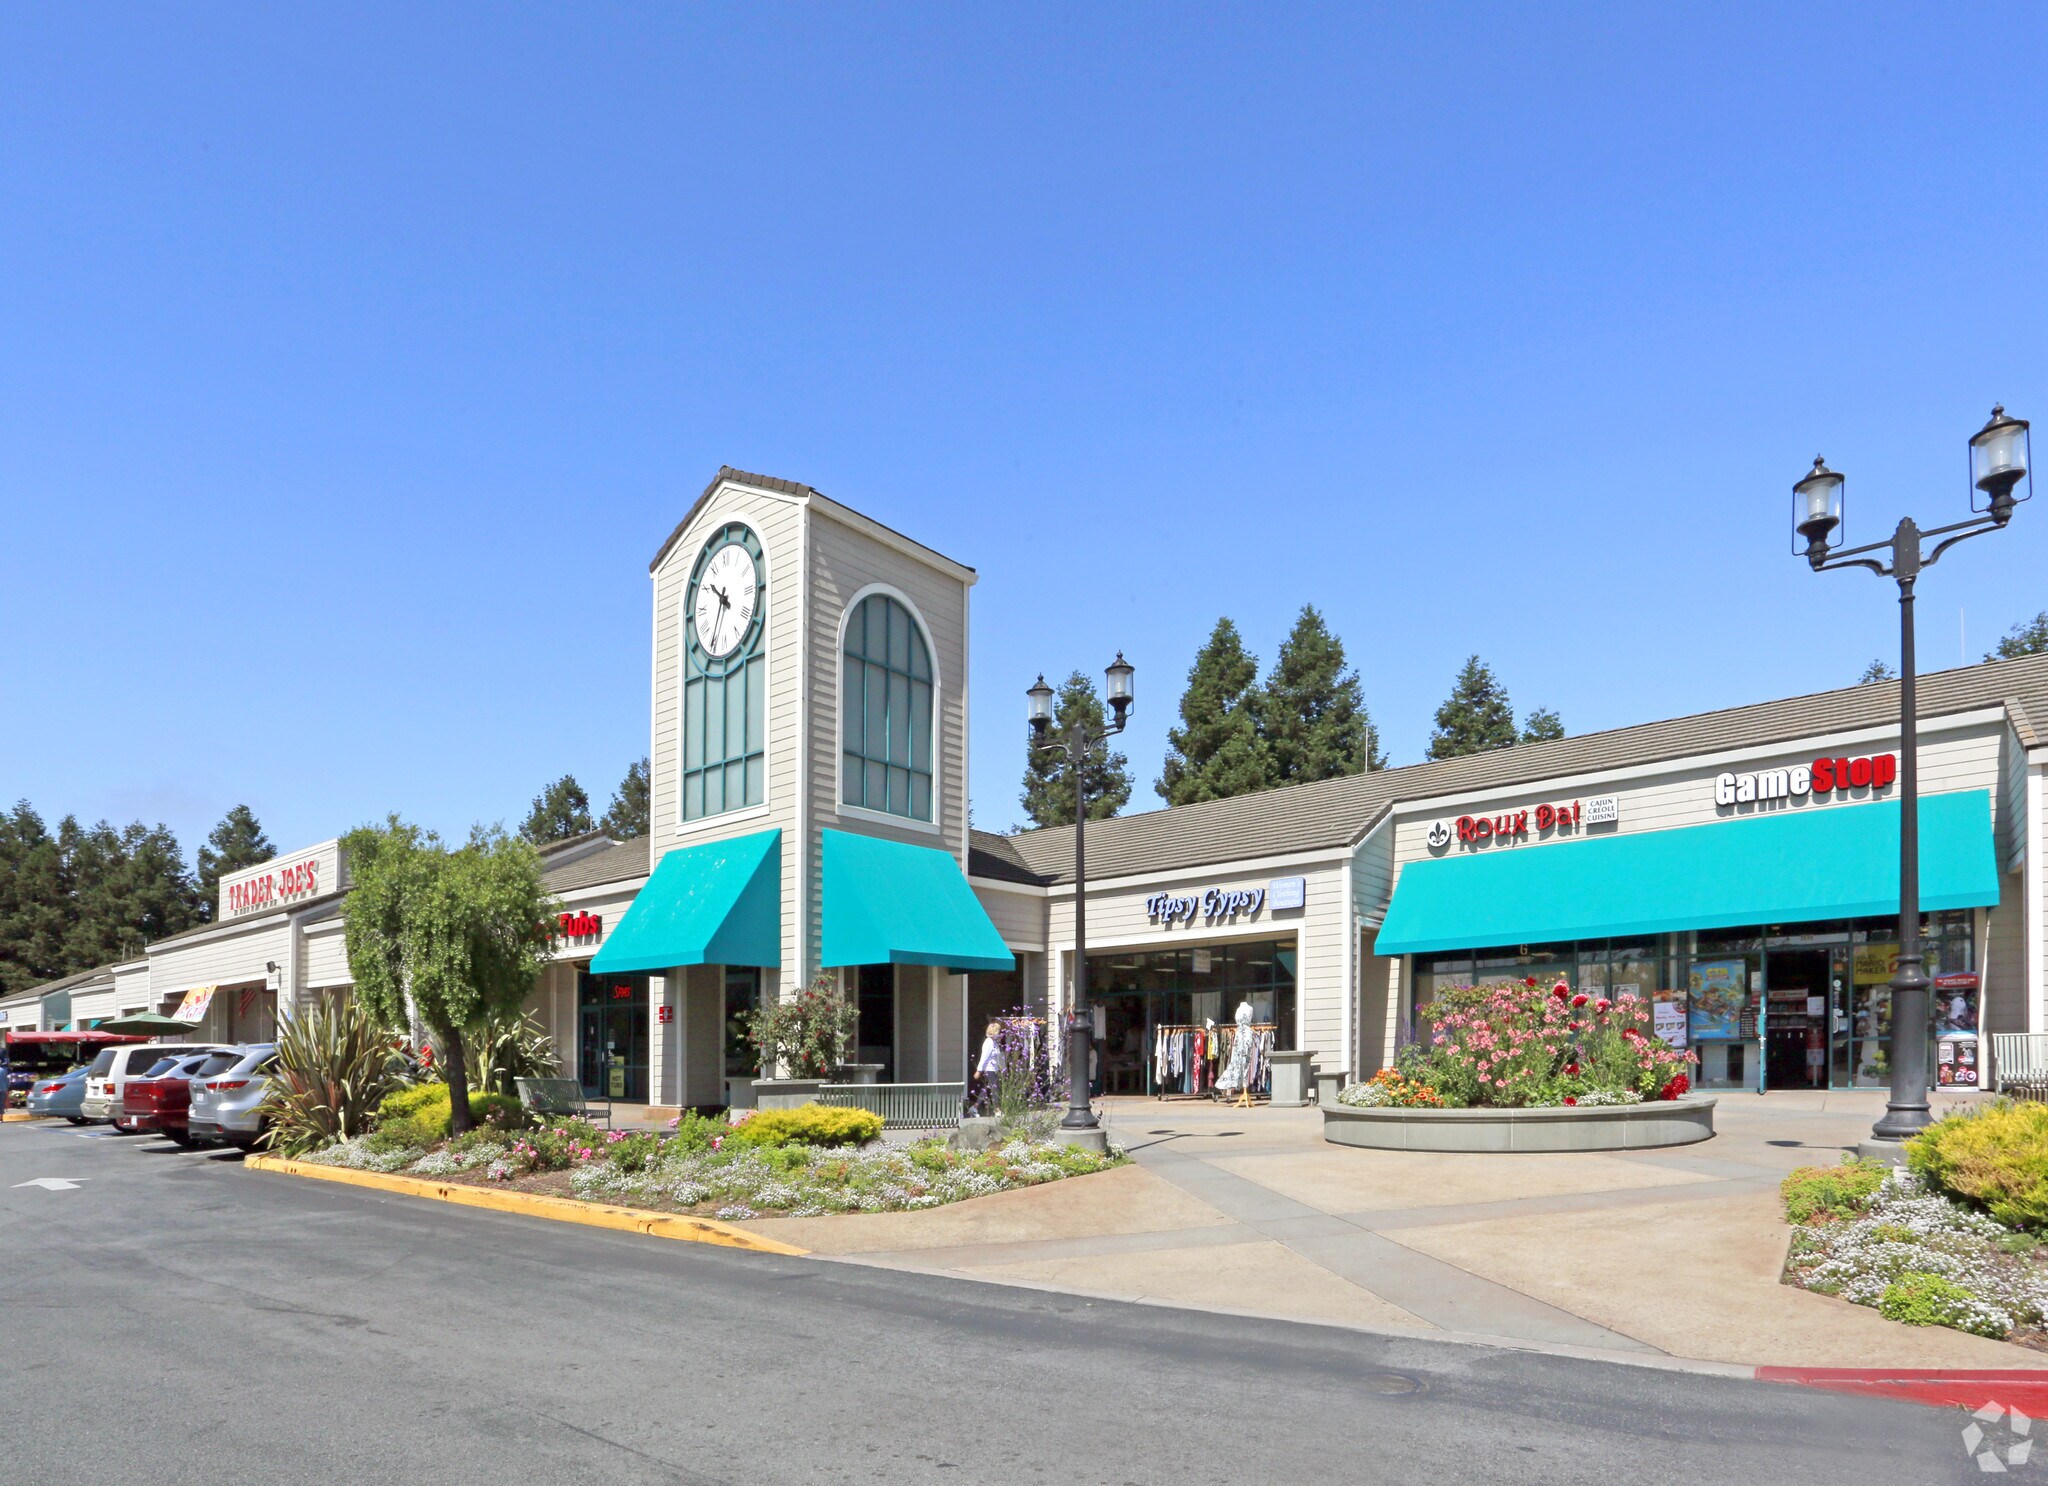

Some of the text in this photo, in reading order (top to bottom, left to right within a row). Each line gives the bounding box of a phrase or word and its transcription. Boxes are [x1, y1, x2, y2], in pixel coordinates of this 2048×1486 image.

[1715, 754, 1895, 806] GameStop
[1589, 798, 1614, 808] CAJUN
[1587, 804, 1615, 815] CREOLE
[1455, 799, 1581, 844] Roux Dat
[1587, 811, 1616, 822] CUISINE
[229, 860, 315, 911] TRADER JOE'S
[1145, 887, 1265, 922] Tipsy Gypsy
[1520, 944, 1528, 956] G
[1855, 959, 1886, 968] MARIO
[1855, 966, 1887, 976] MAKER
